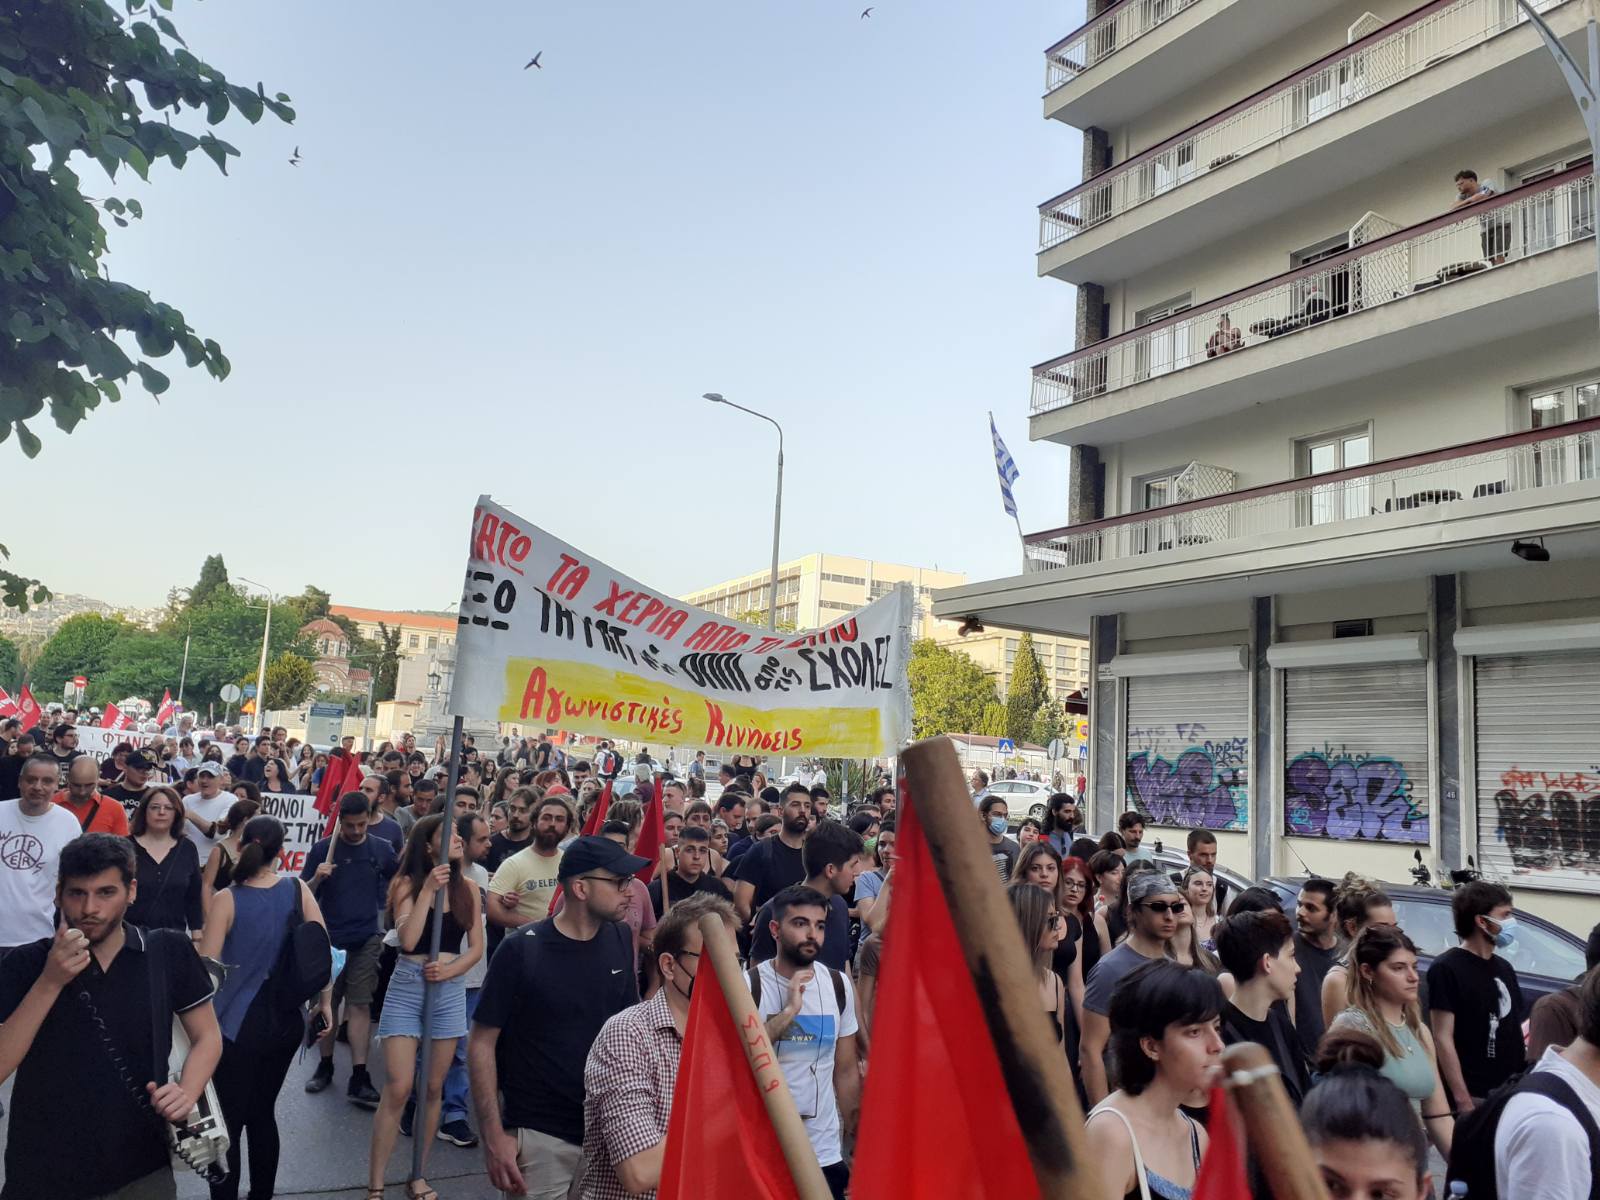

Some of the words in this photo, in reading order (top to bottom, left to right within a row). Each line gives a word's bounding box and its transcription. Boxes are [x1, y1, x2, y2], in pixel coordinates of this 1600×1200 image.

[546, 553, 590, 600] ΤΑ
[593, 579, 689, 640] ΧΕΡΙΑ
[683, 621, 751, 652] ΑΠΟ
